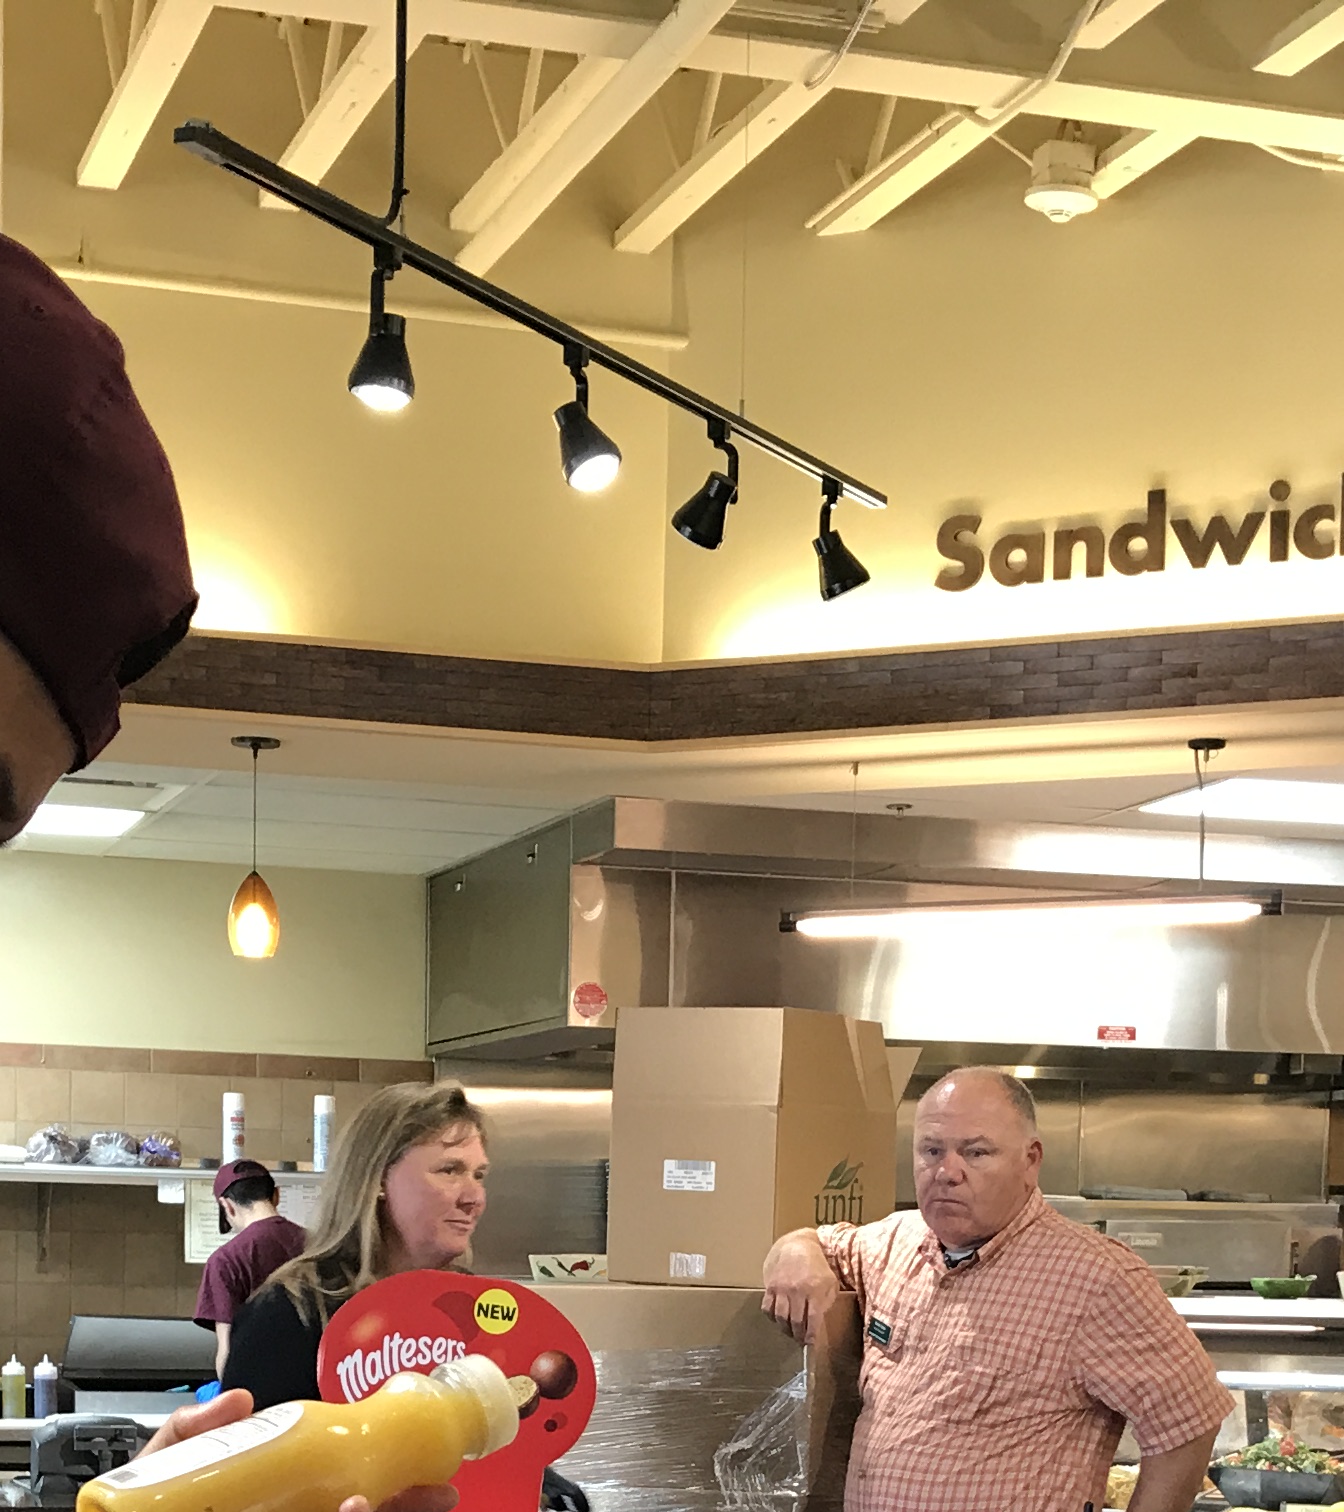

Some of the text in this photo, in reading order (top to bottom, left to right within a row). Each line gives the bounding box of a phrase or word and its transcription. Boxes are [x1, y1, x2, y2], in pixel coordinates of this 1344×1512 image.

[814, 1178, 864, 1225] unfi
[476, 1302, 517, 1322] NEW
[336, 1331, 466, 1404] Maltesers
